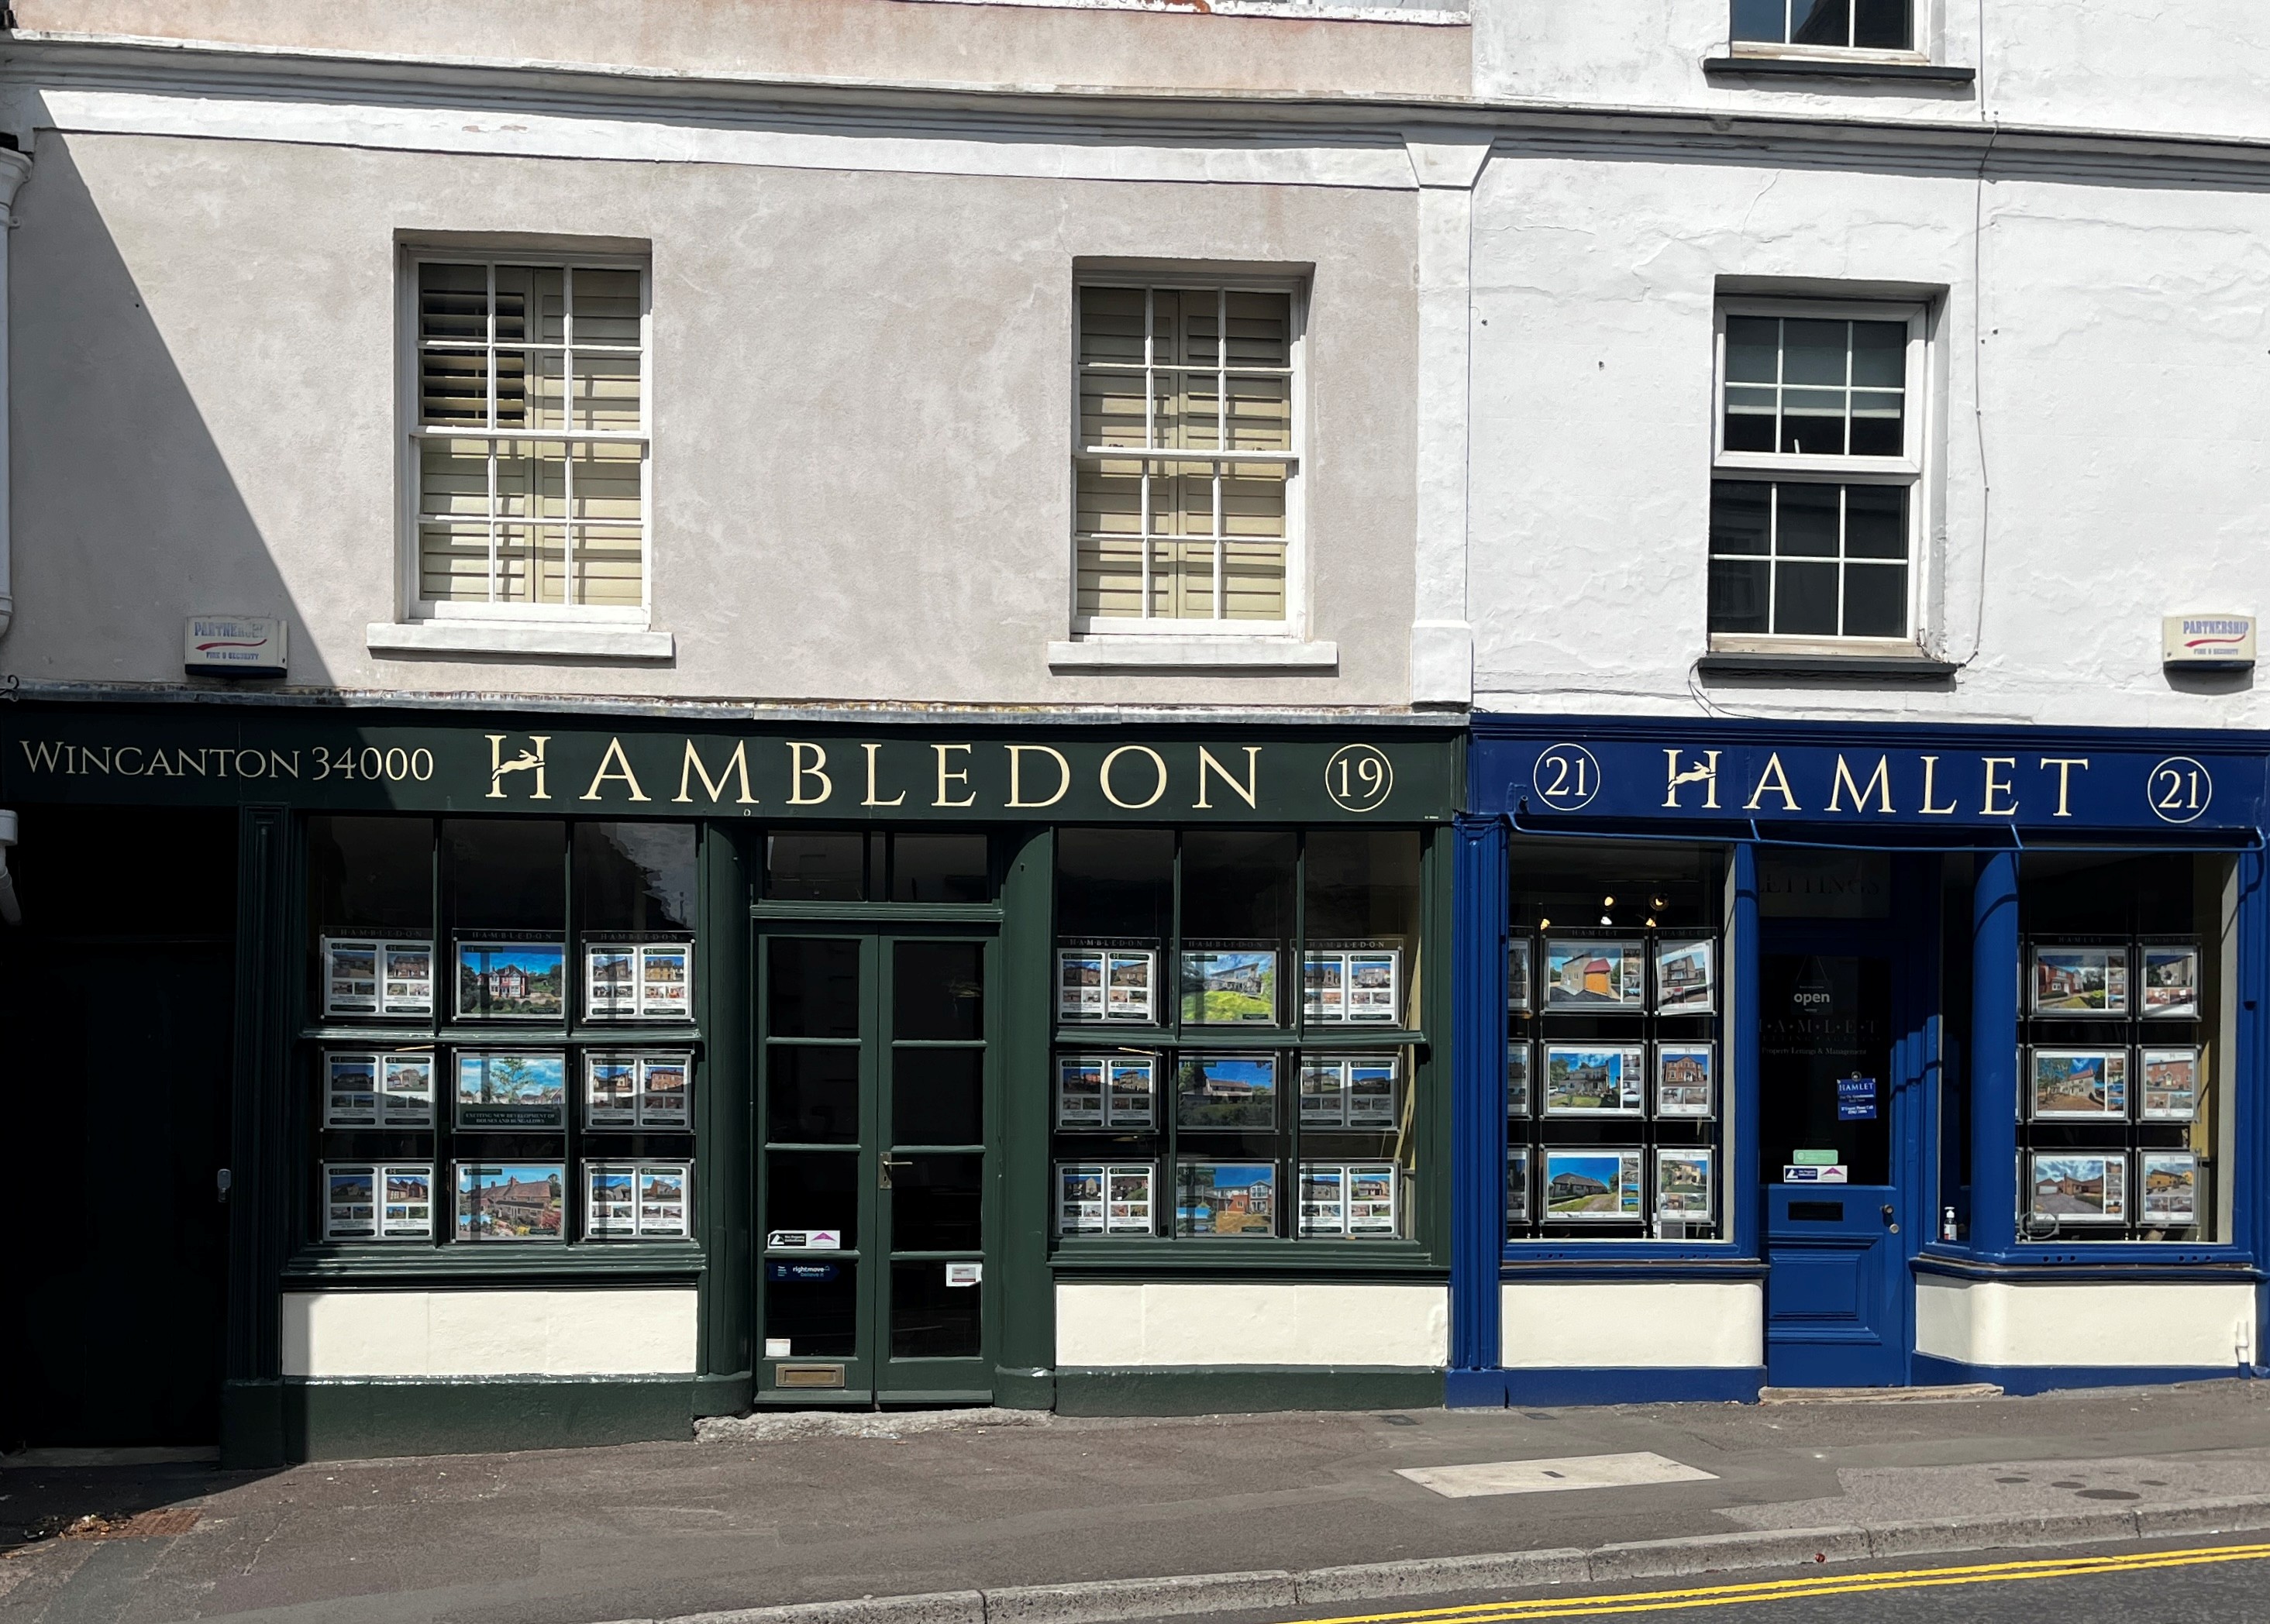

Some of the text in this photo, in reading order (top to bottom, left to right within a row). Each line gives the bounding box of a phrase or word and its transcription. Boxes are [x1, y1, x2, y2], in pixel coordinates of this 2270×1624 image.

[2182, 620, 2249, 635] PARTNERSHIP
[19, 740, 435, 781] WINCANTON 34000
[484, 735, 1263, 810] HAMBLEDON
[1337, 757, 1384, 798] 19
[1545, 755, 1589, 797] 21
[1661, 748, 2089, 817] HAMLET
[2158, 769, 2199, 810] 21
[1793, 993, 1831, 1006] open
[1762, 1047, 1789, 1056] Property
[1825, 1047, 1867, 1056] Management
[1839, 1082, 1874, 1091] HAMLET
[792, 1265, 825, 1274] rightmove
